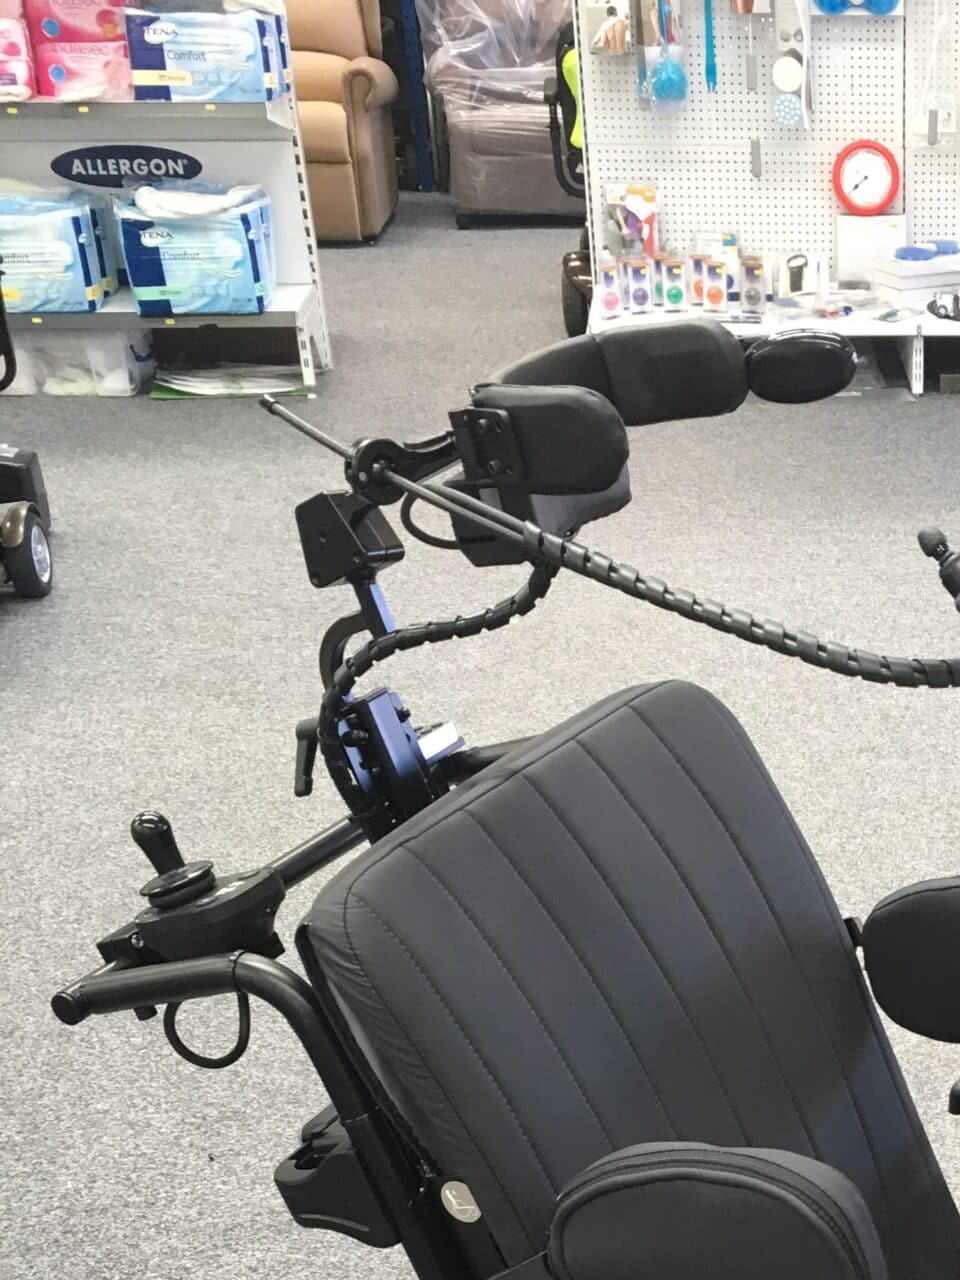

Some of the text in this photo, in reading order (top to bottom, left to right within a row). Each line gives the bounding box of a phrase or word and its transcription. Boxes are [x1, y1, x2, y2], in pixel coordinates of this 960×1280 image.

[143, 25, 179, 36] TENA
[166, 49, 207, 62] Comfort
[142, 230, 174, 239] TENA
[162, 250, 201, 262] Comfort
